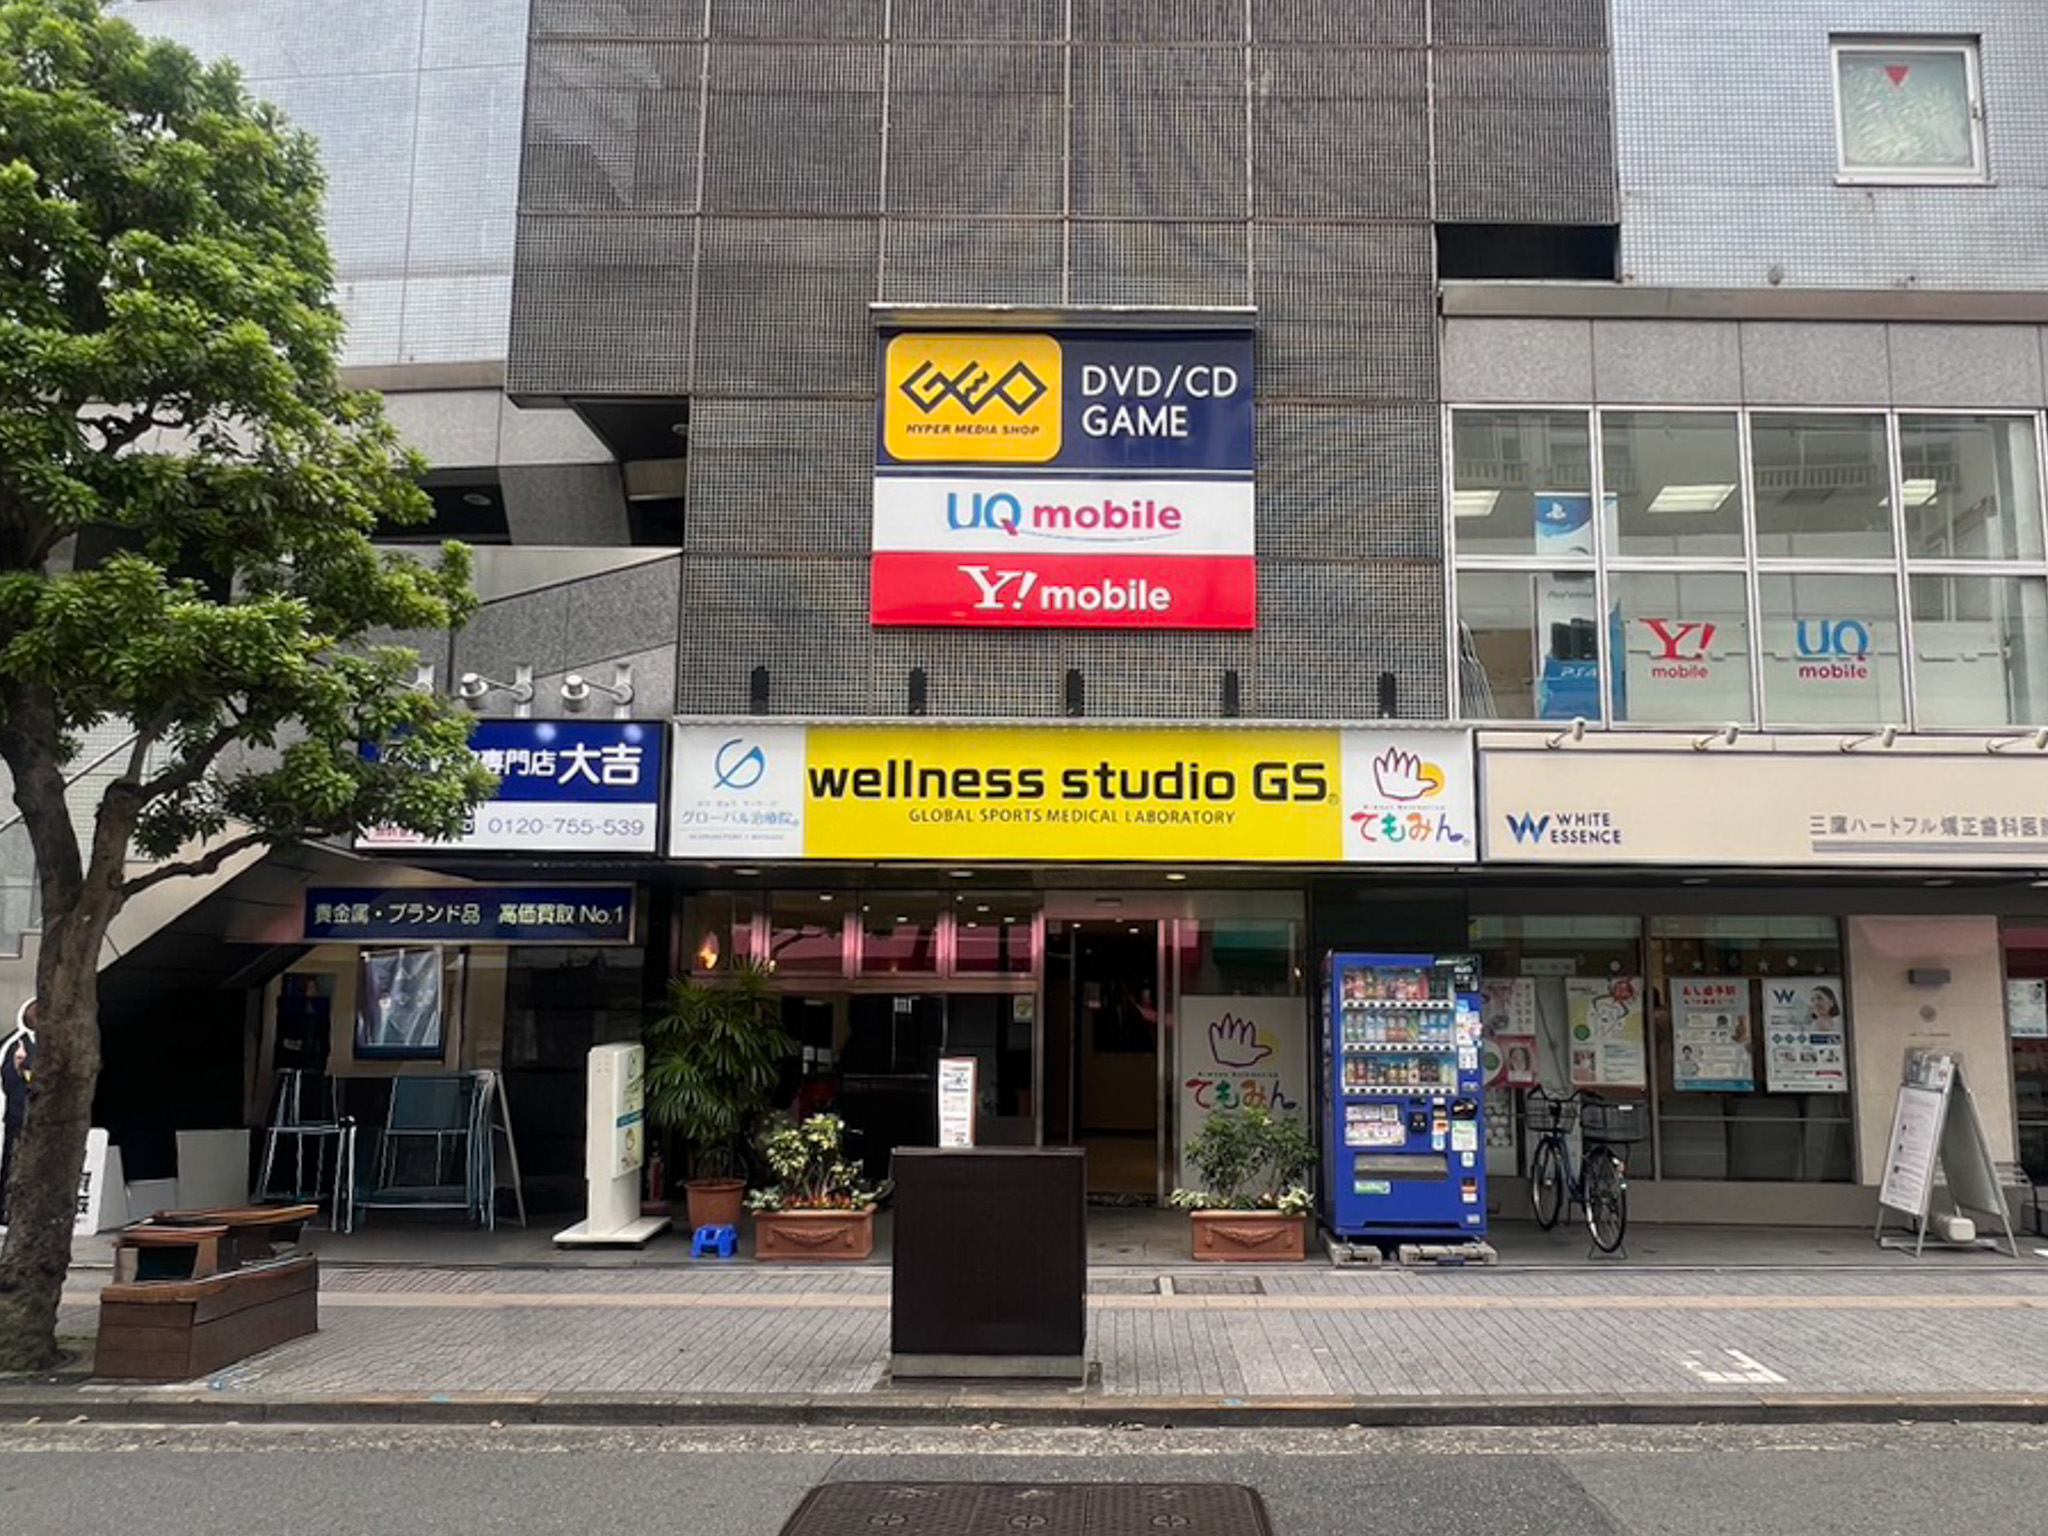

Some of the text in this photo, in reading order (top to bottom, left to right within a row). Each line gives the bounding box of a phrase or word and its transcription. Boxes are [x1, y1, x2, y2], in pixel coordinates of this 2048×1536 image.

[1081, 364, 1239, 398] DVD/CD
[906, 423, 1040, 436] HYPER MEDIA SHOP
[1081, 405, 1189, 438] GAME
[947, 492, 1182, 536] UQ mobile
[958, 565, 1171, 611] Y! mobile
[1639, 618, 1717, 660] Y!
[1797, 619, 1869, 661] UQ
[1652, 665, 1709, 679] mobile
[1799, 665, 1868, 679] mobile
[807, 759, 1327, 802] wellness studio GS
[488, 817, 645, 837] 0120-755-539
[908, 808, 1236, 824] GLOBAL SPORTS MEDICAL LABORATORY
[1350, 811, 1465, 843] てもみん
[1556, 812, 1611, 826] WHITE
[1550, 829, 1622, 844] ESSENCE
[497, 902, 575, 925] 高価買取
[579, 904, 624, 925] No.1
[1185, 1078, 1298, 1110] てもみん
